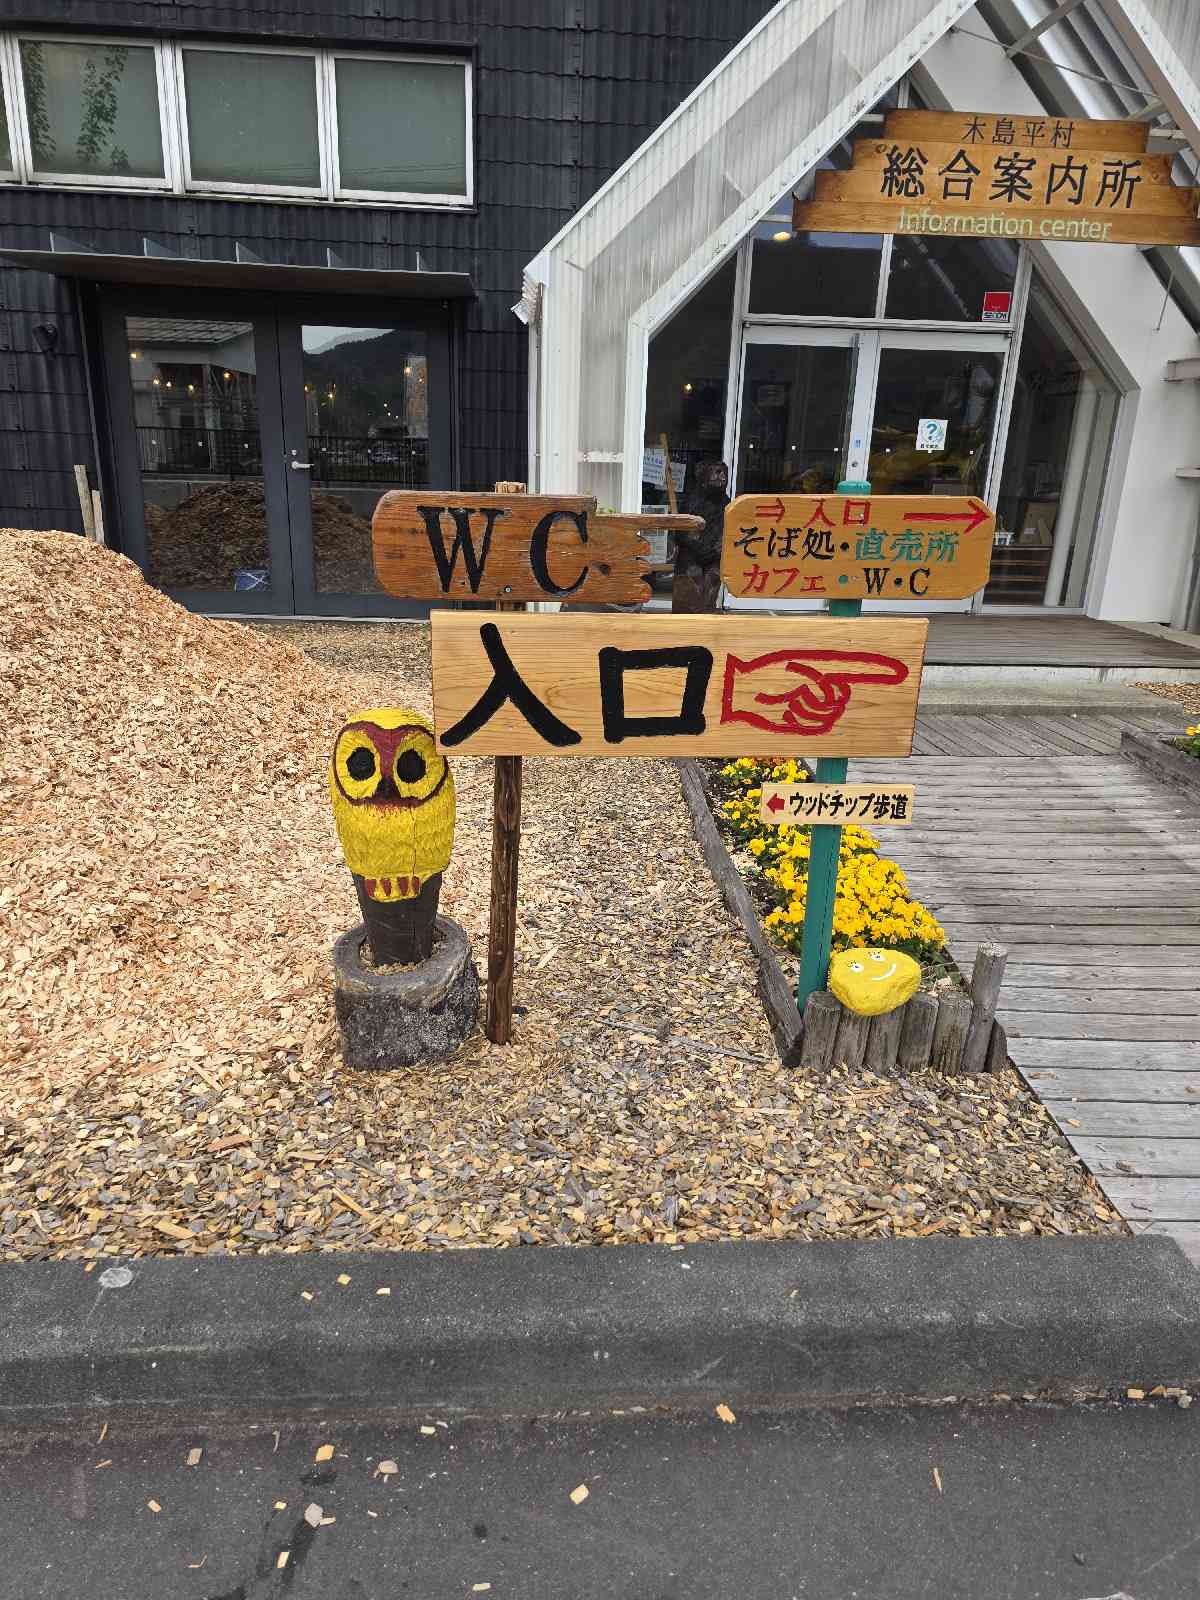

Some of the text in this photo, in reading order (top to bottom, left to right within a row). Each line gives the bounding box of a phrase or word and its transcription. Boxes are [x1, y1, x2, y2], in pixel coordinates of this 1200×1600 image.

[962, 117, 1075, 149] 木島平村
[879, 144, 1143, 209] 総合案内所
[898, 206, 1113, 242] Information center
[802, 498, 872, 527] 入口
[439, 622, 714, 747] 入口
[789, 791, 909, 820] ウッドチップ歩道
